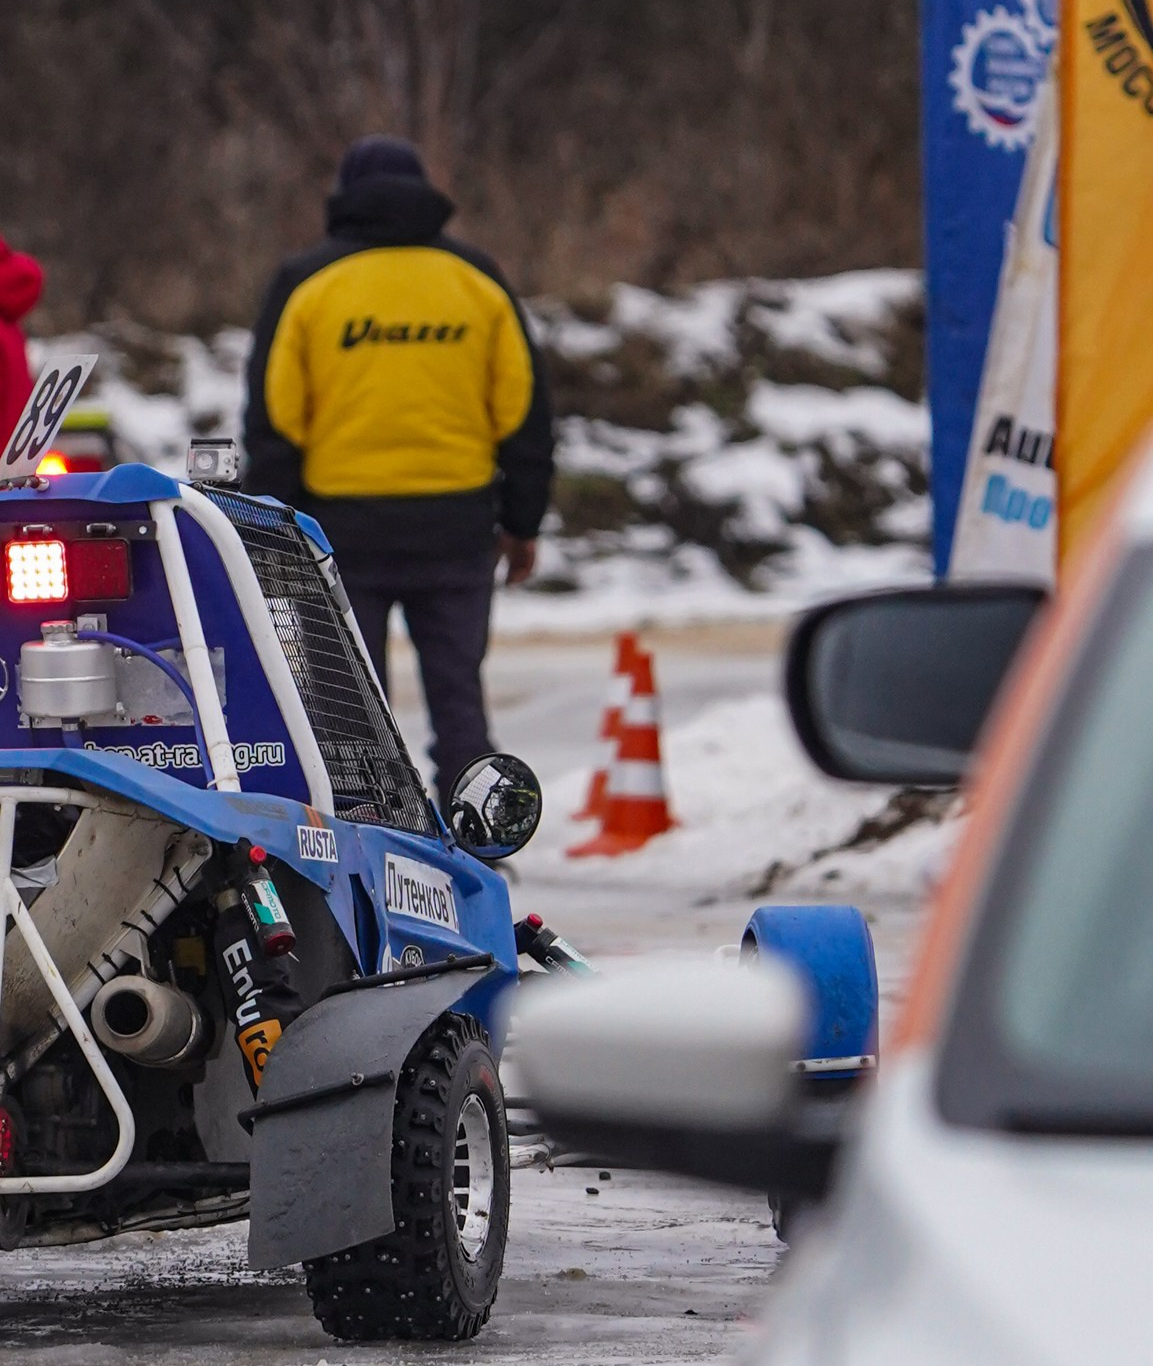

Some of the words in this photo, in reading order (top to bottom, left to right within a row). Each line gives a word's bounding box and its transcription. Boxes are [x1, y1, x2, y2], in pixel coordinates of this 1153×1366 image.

[1084, 13, 1153, 117] МОС
[6, 365, 82, 465] 89
[299, 828, 338, 860] RUSTA
[387, 861, 450, 923] Путенков
